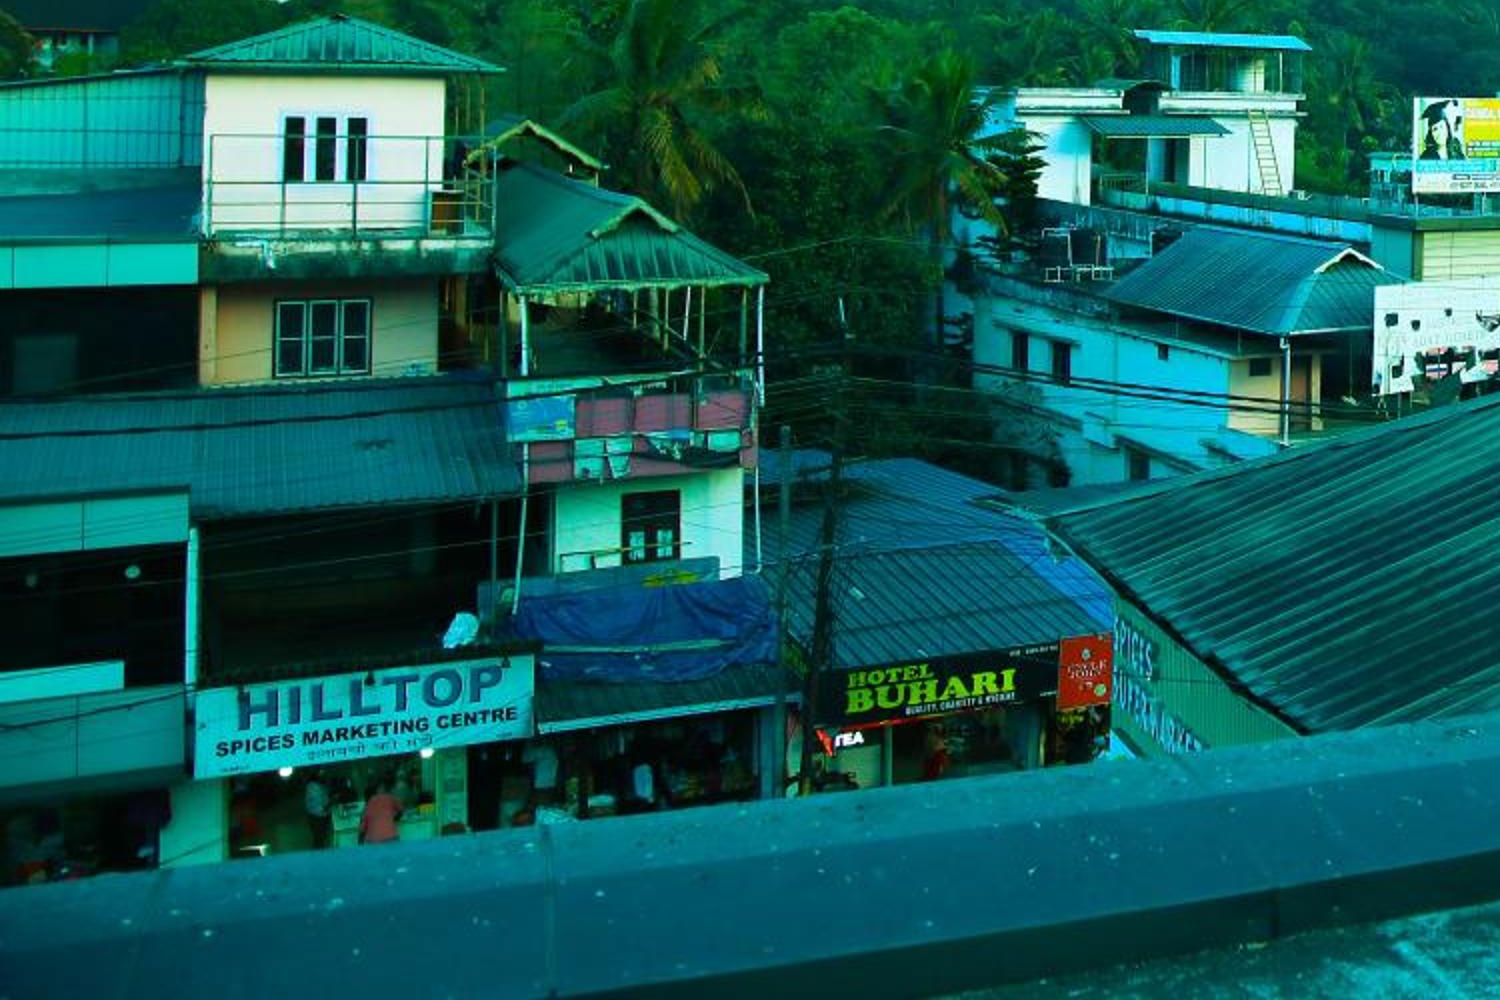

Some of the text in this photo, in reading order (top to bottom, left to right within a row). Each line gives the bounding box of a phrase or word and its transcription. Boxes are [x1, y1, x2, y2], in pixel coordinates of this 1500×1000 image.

[237, 665, 503, 731] HILLTOP
[845, 669, 1017, 714] BUHARI
[847, 664, 934, 689] HOTEL
[215, 733, 296, 758] SPICES
[302, 718, 429, 746] MARKETING
[436, 707, 518, 729] CENTRE
